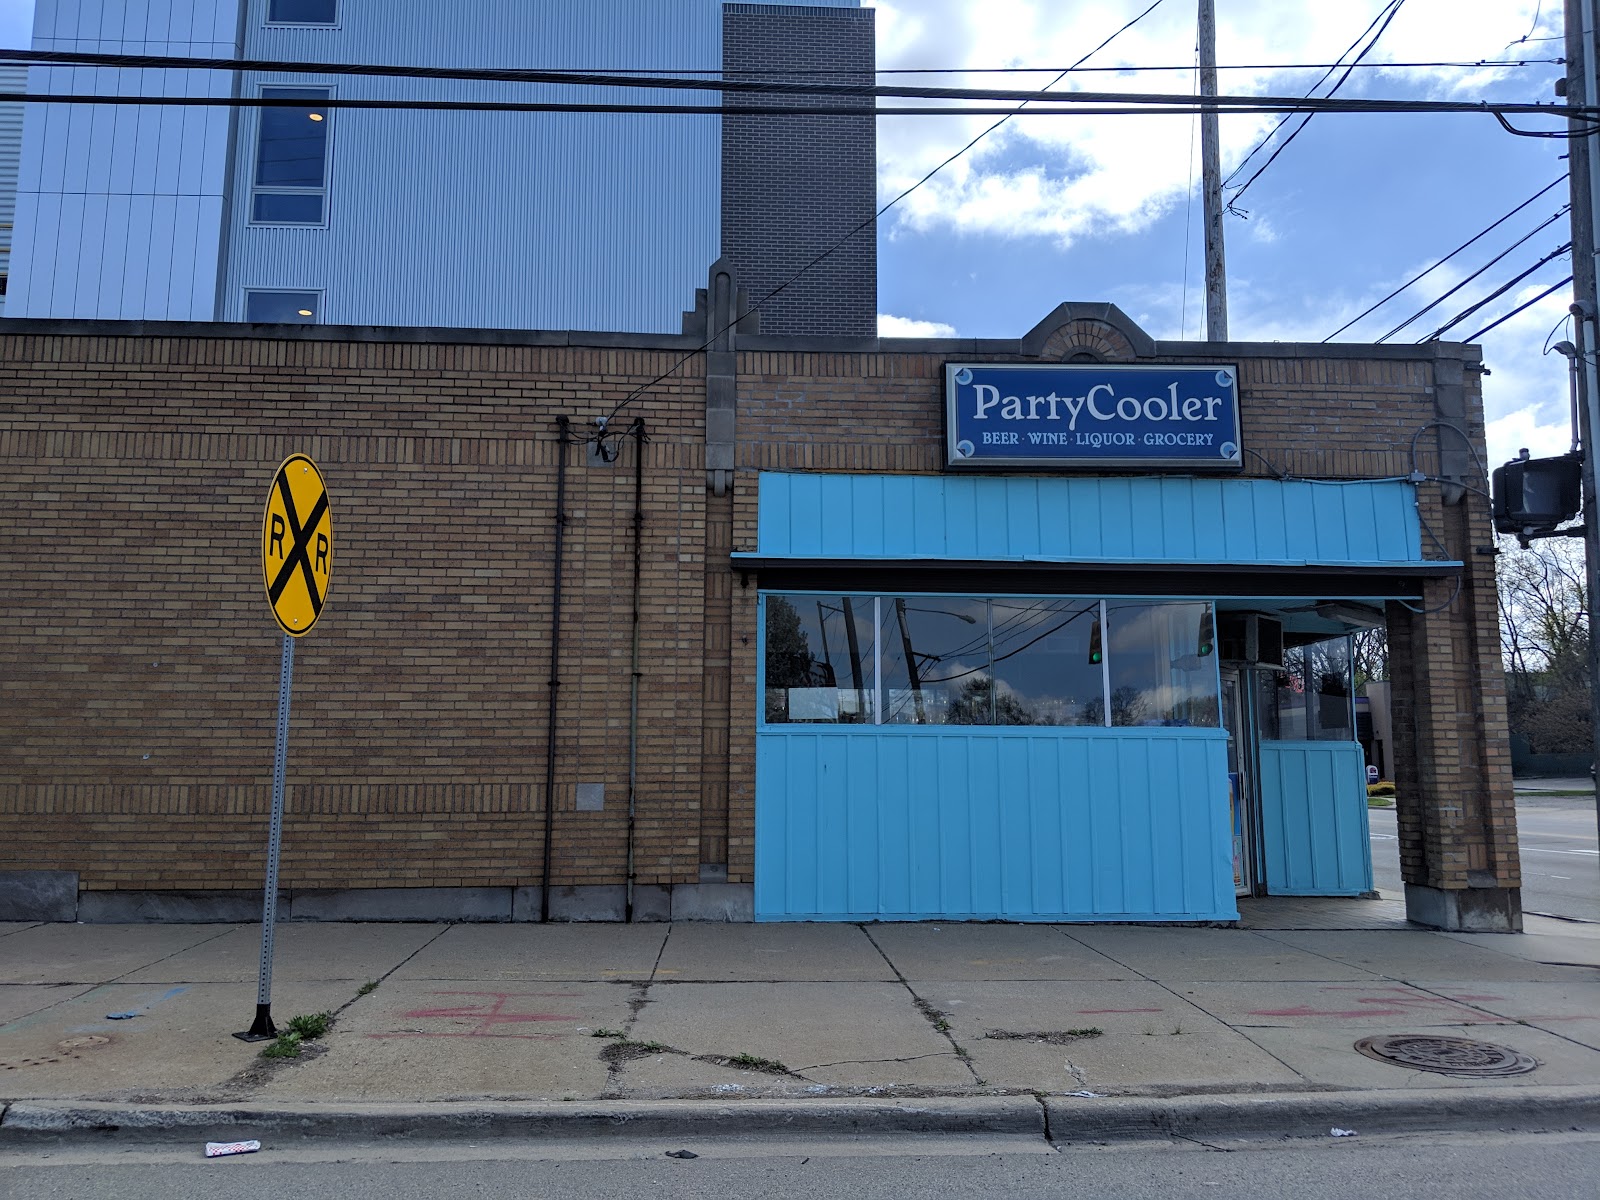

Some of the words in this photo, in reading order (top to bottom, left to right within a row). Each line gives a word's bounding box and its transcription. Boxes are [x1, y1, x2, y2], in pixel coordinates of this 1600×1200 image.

[982, 432, 1019, 445] BEER
[1027, 432, 1067, 446] WINE
[1076, 433, 1135, 448] LIQUOR
[1143, 433, 1214, 446] GROCERY
